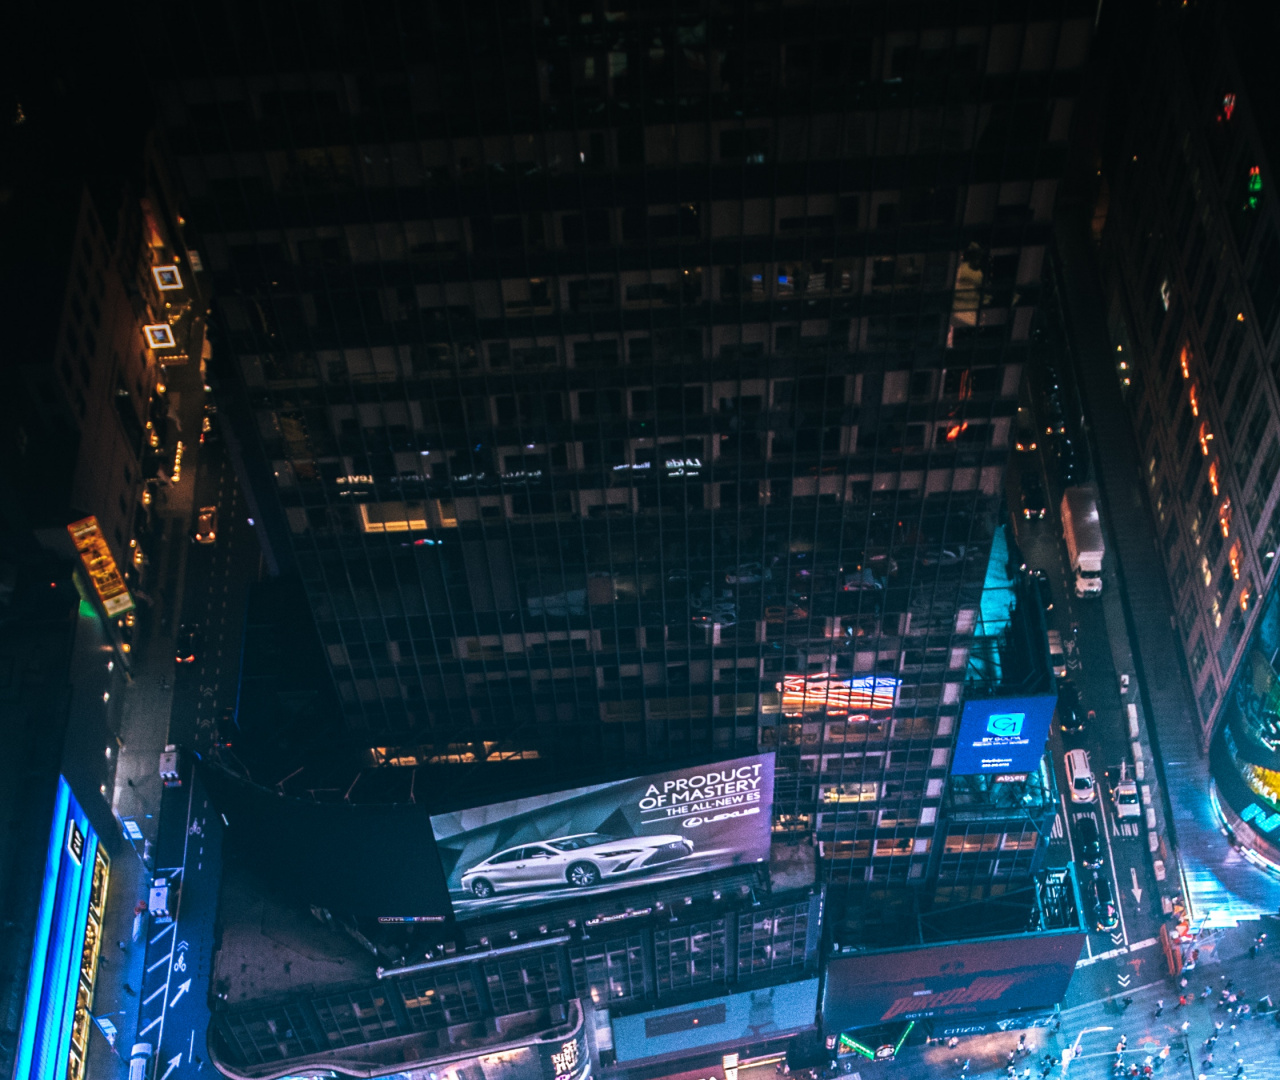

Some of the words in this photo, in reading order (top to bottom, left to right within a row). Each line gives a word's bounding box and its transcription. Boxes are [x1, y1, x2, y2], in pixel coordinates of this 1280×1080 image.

[645, 784, 660, 797] A
[664, 764, 762, 793] PRODUCT
[639, 795, 666, 810] OF
[671, 777, 761, 804] MASTERY
[666, 806, 688, 817] THE
[691, 795, 743, 811] ALL-NEW
[746, 791, 760, 801] ES
[703, 807, 760, 823] LEXUS
[73, 830, 82, 855] GAP
[944, 1025, 986, 1035] CITIZEN
